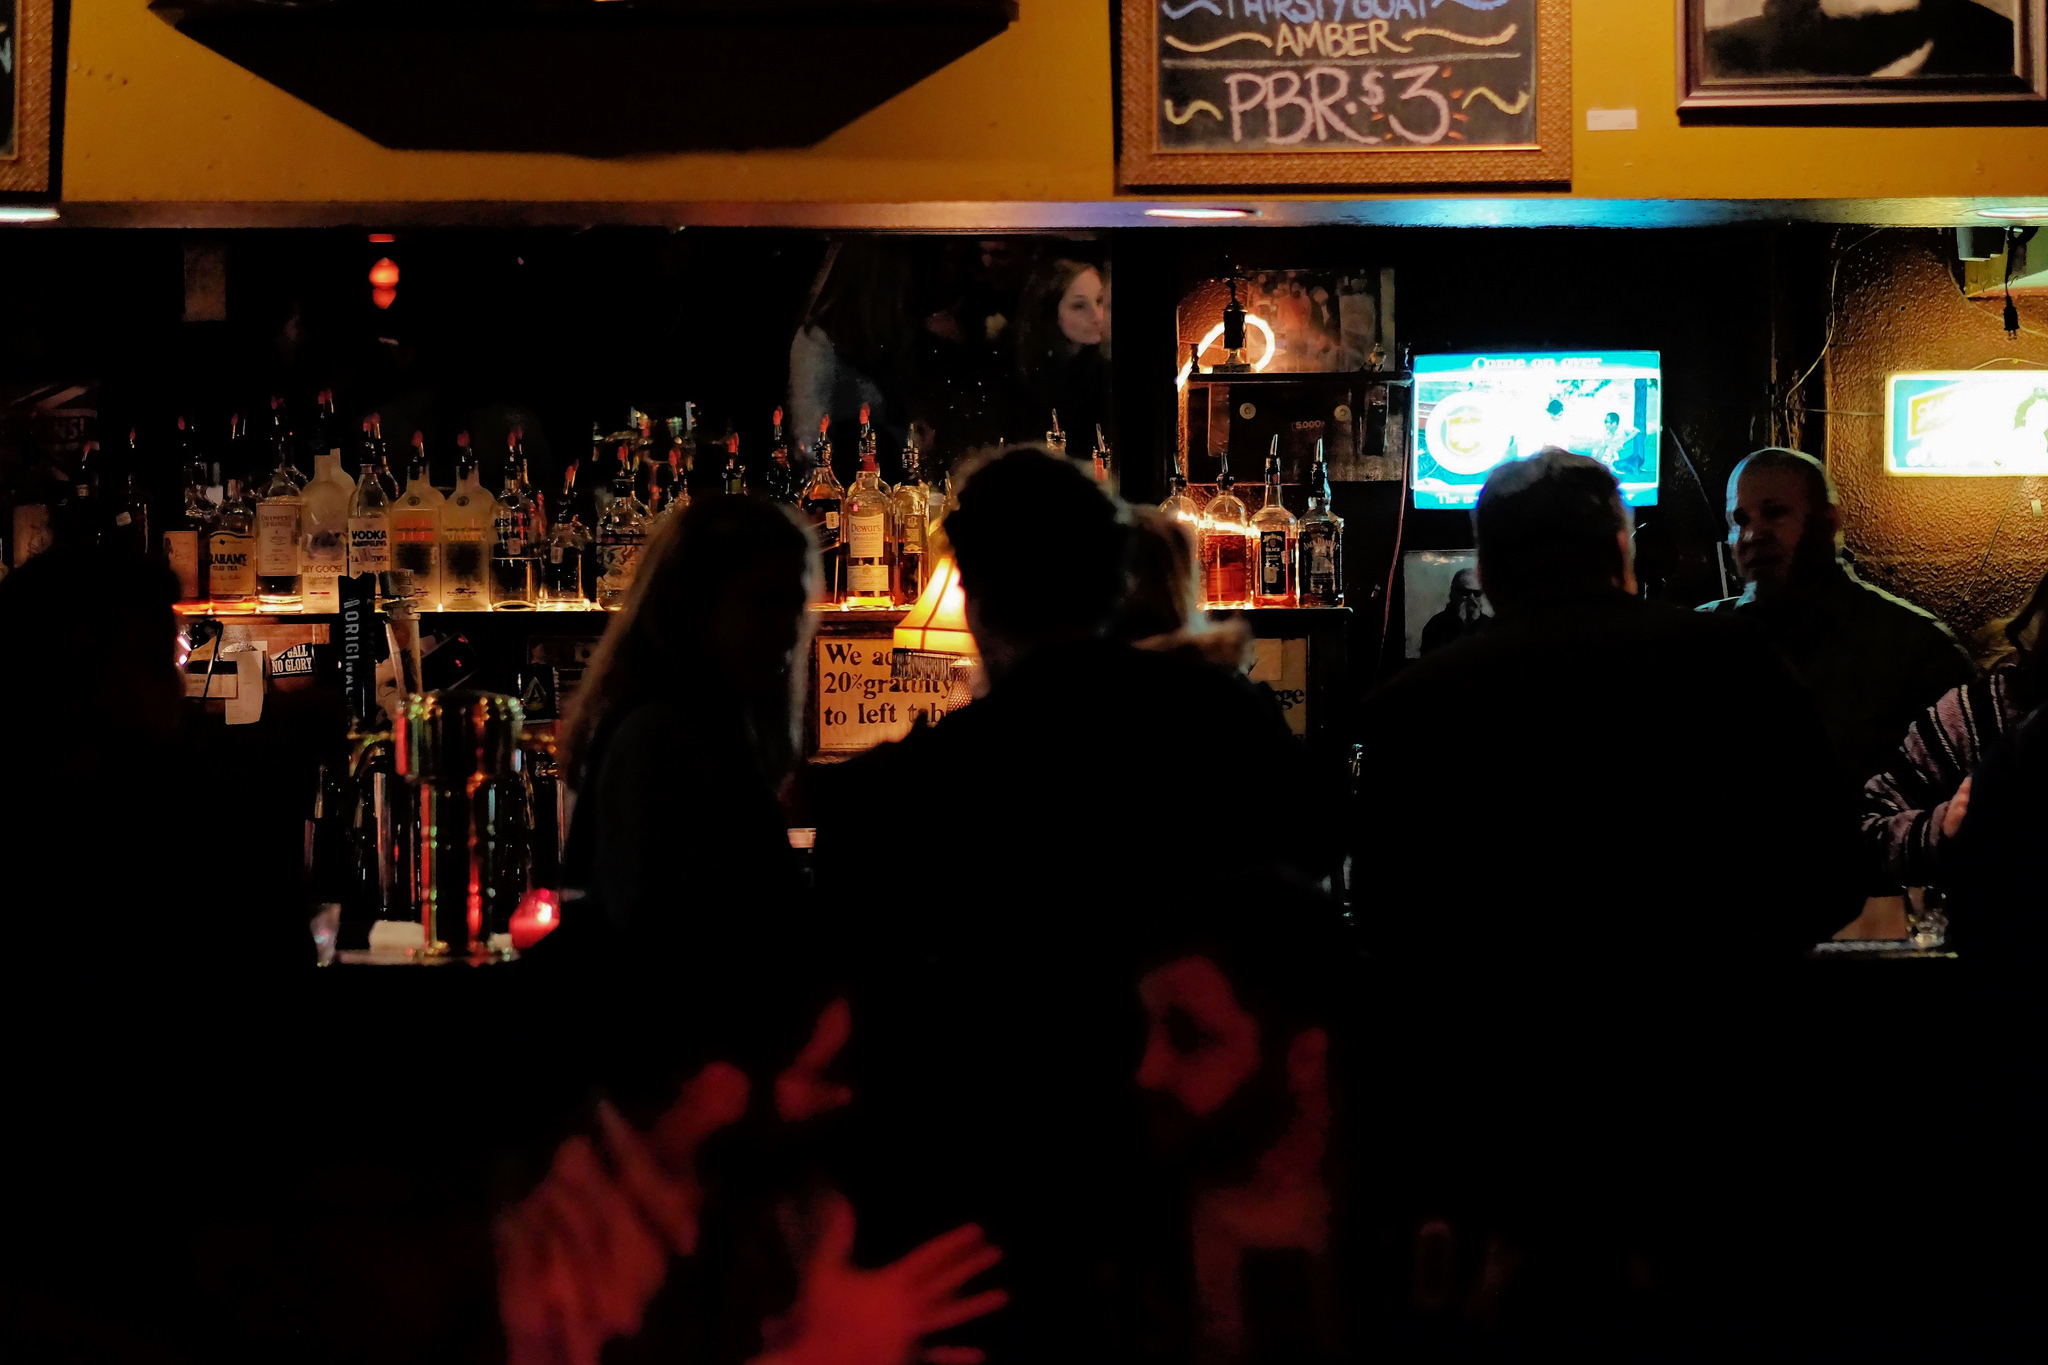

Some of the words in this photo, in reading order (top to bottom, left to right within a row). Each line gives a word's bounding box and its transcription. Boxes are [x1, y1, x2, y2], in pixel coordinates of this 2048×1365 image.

[1275, 19, 1413, 58] AMBER
[1472, 357, 1526, 370] Come
[1531, 358, 1556, 369] on
[1561, 357, 1602, 369] over
[1436, 492, 1460, 504] The
[351, 530, 387, 540] VODKA
[315, 565, 344, 573] GOOSE
[825, 643, 862, 666] We
[271, 659, 284, 673] NO
[285, 657, 313, 672] GLORY
[824, 706, 848, 726] to
[858, 702, 898, 725] left
